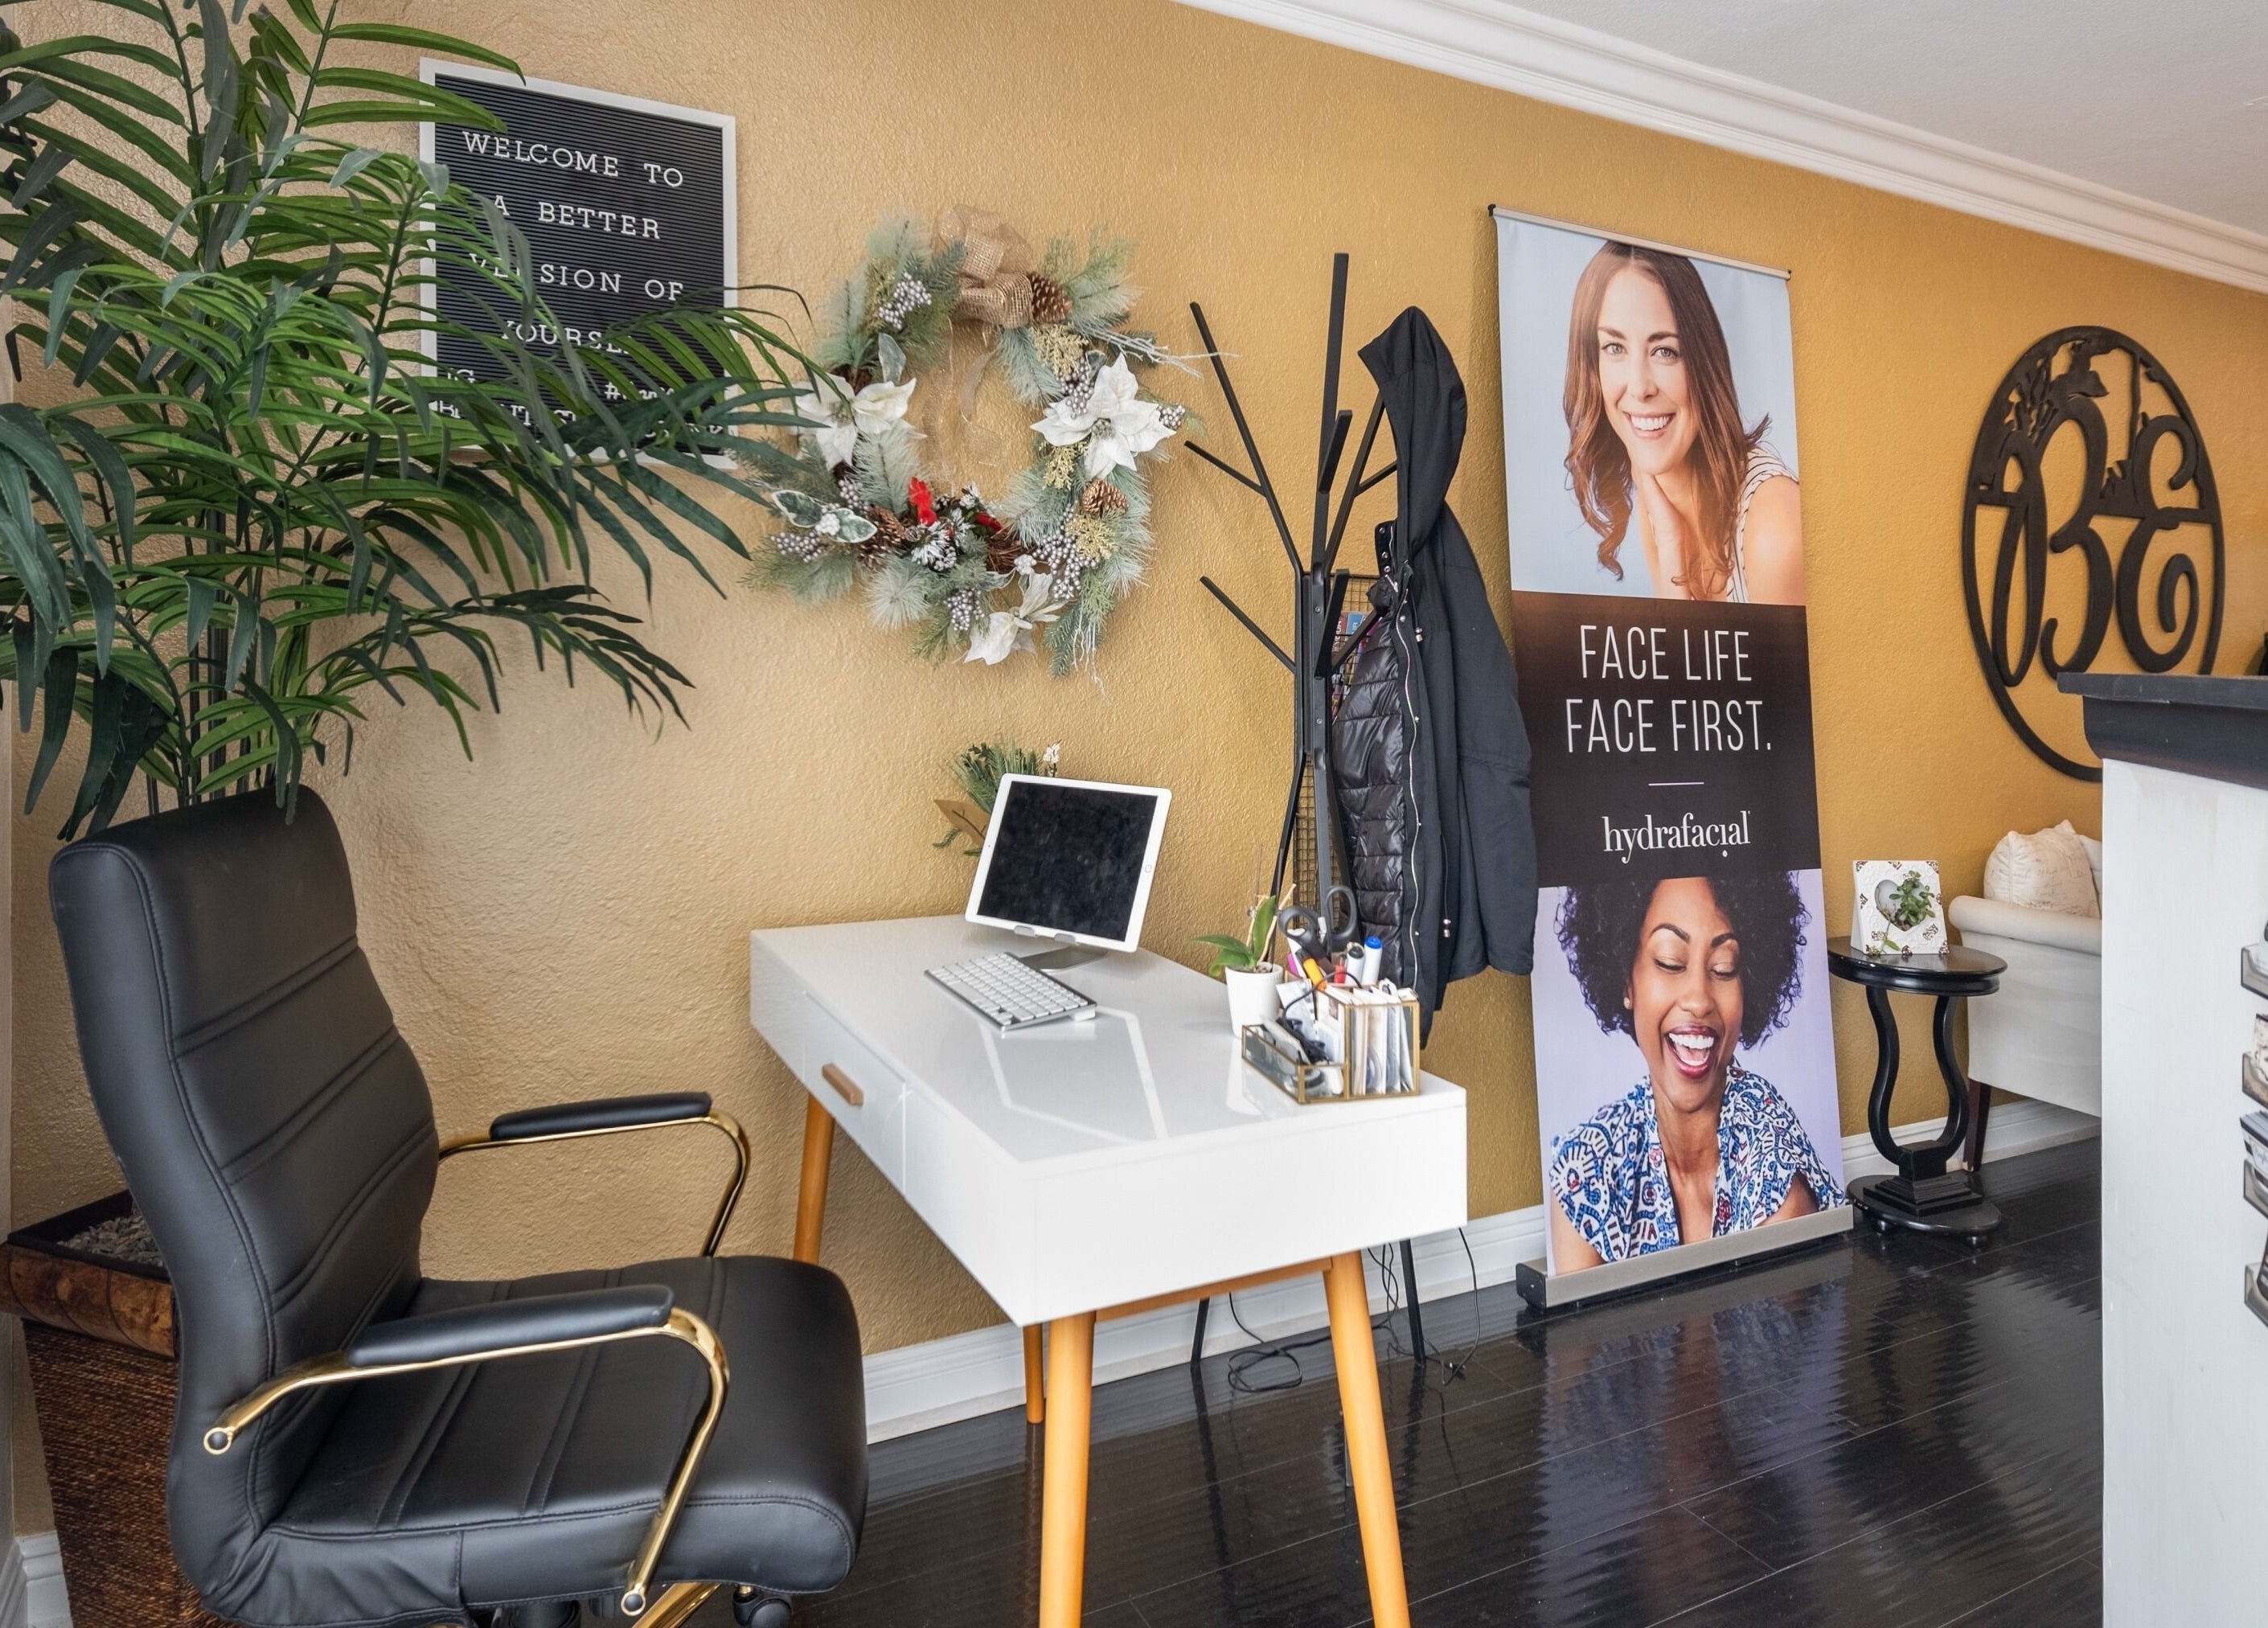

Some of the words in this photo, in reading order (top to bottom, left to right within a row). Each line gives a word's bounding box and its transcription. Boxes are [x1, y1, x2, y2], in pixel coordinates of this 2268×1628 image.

[461, 130, 619, 178] WELCOME
[644, 162, 683, 188] TO
[493, 194, 510, 216] A
[538, 201, 661, 240] BETTER
[470, 252, 621, 293] ESION
[644, 279, 683, 301] OF
[501, 320, 630, 355] YOURS
[1580, 625, 1669, 680] FACE
[1684, 629, 1752, 682] LIFE
[1566, 698, 1656, 753] FACE
[1671, 699, 1770, 752] FIRST.
[1602, 810, 1751, 864] hydrafacial
